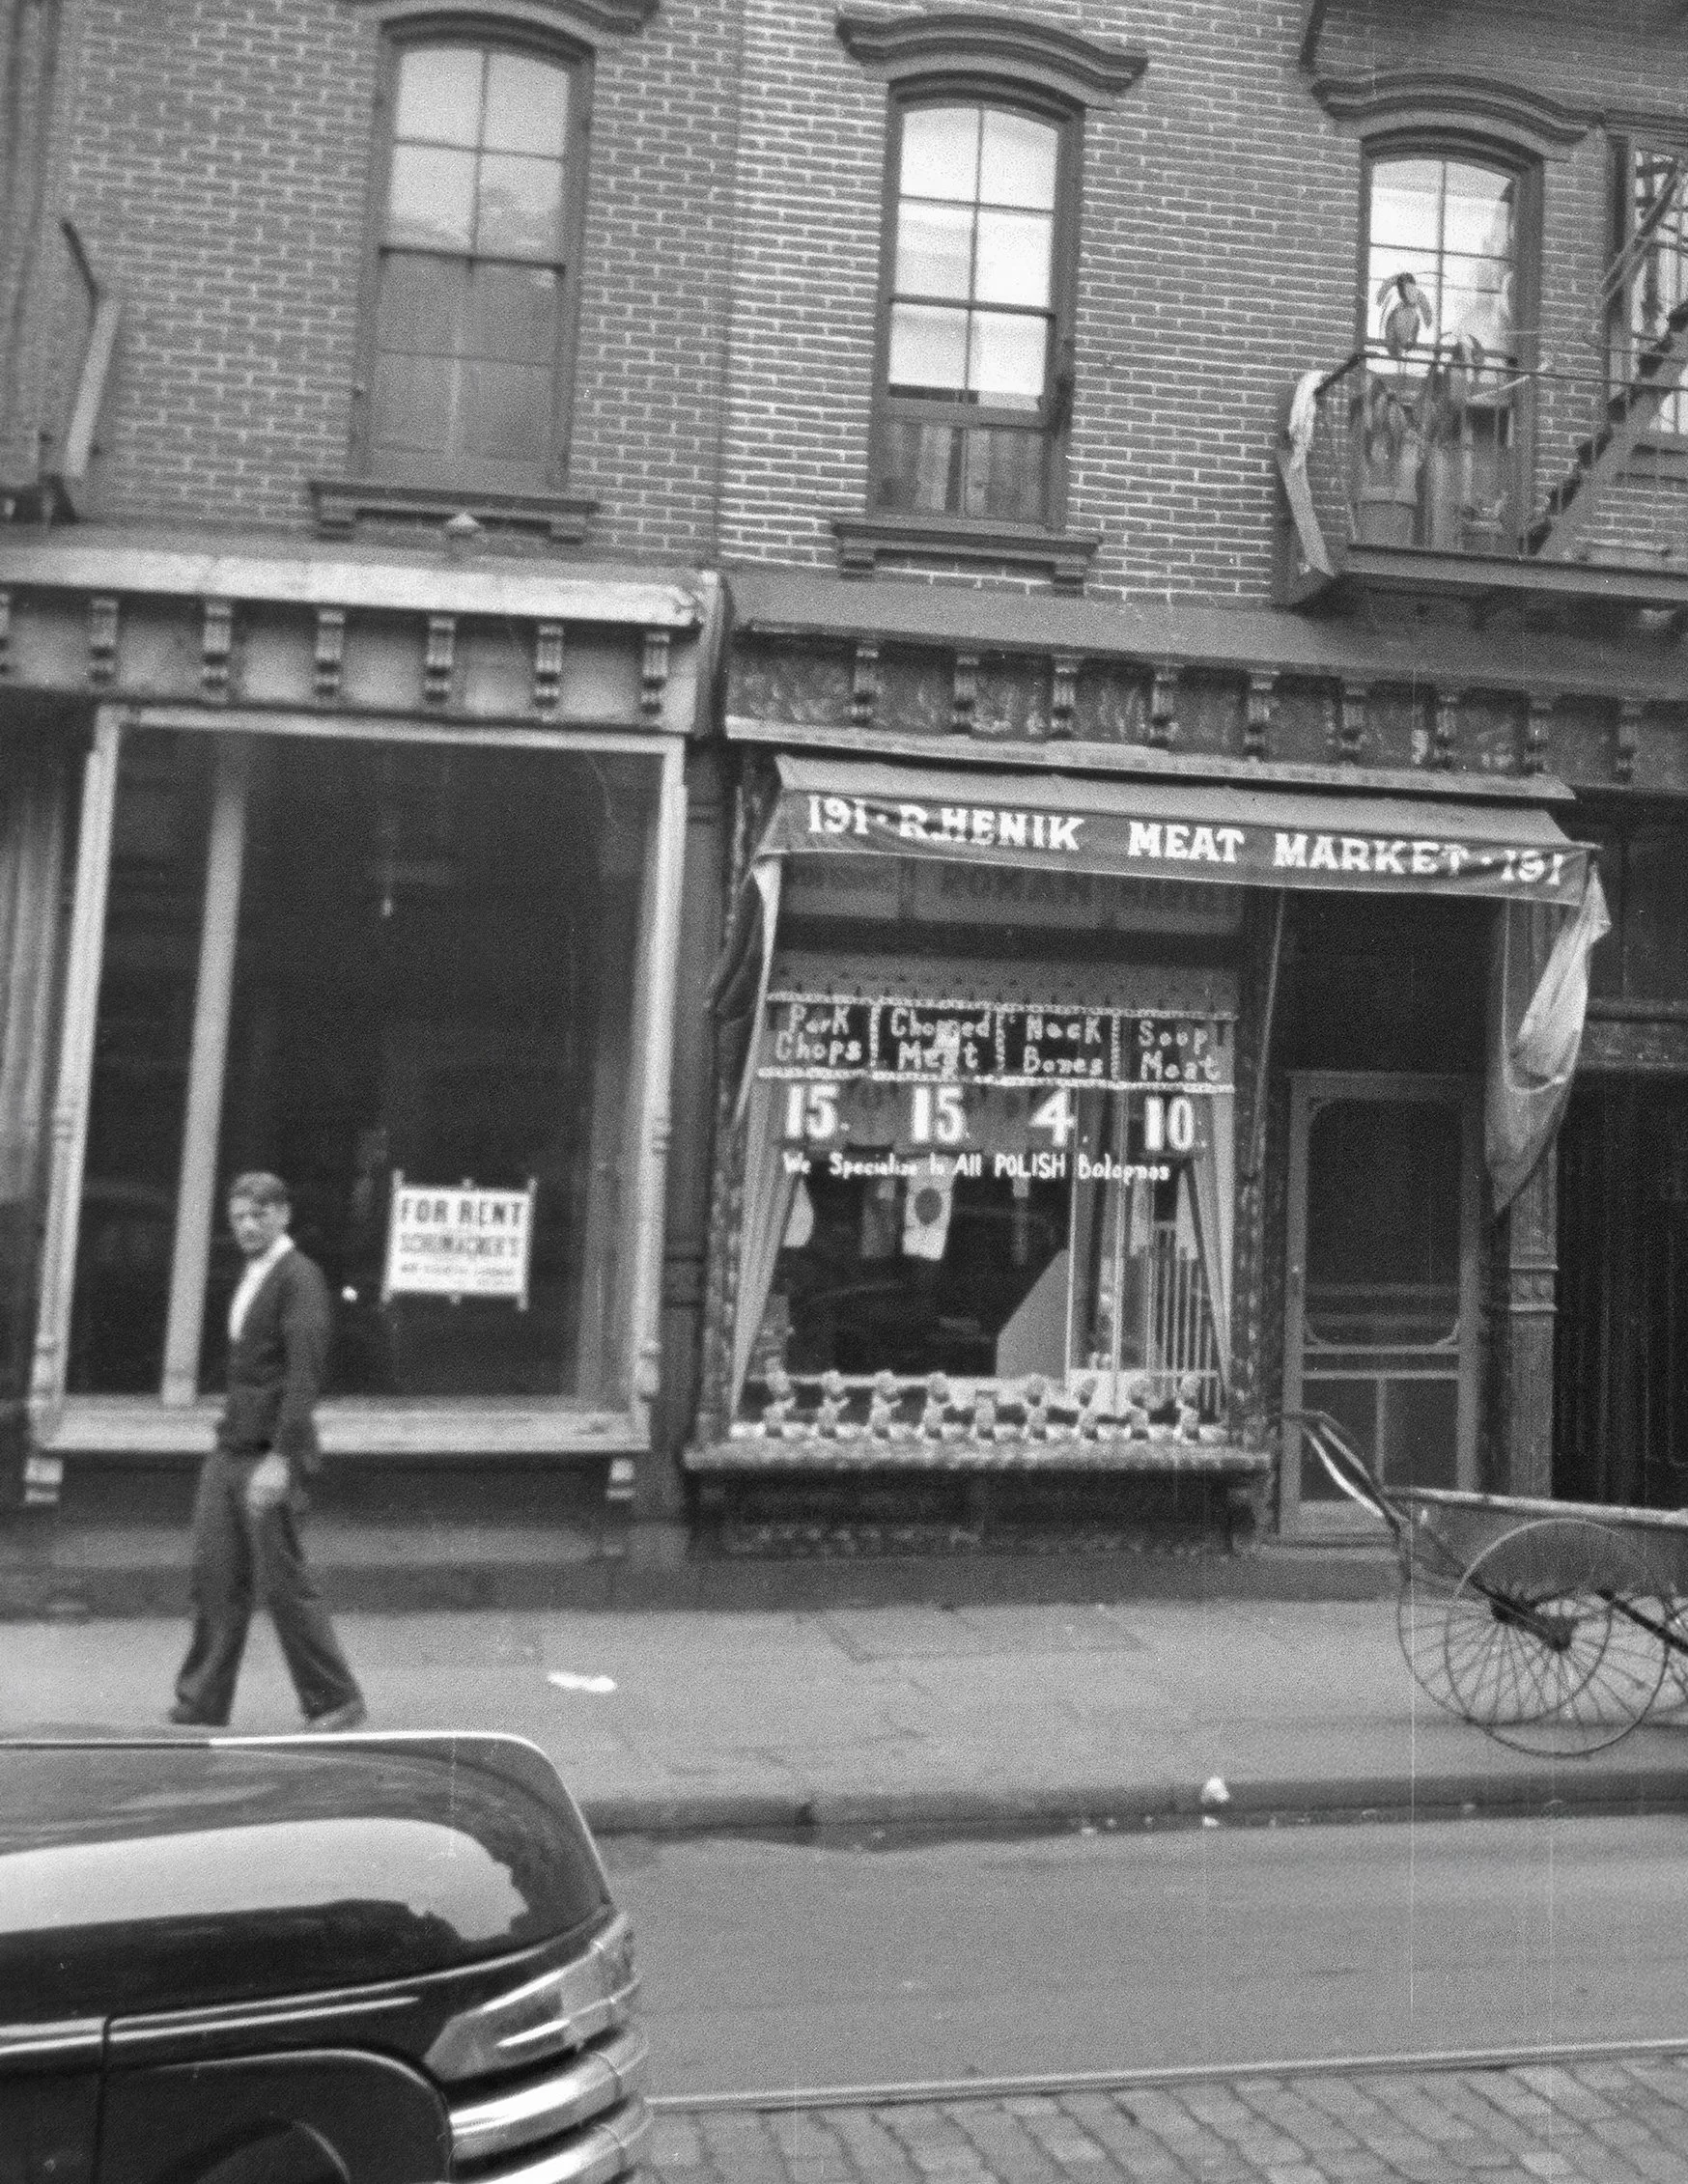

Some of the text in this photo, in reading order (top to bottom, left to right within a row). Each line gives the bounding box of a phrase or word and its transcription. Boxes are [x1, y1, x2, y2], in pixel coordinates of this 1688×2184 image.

[1127, 821, 1246, 863] MEAT
[1272, 831, 1469, 877] MARKET
[889, 1007, 992, 1038] Choed
[1138, 1020, 1209, 1056] Soup
[774, 1029, 862, 1066] Chops
[1024, 1045, 1104, 1077] Bones
[1139, 1050, 1222, 1081] Meat
[911, 1085, 966, 1145] 15
[1143, 1095, 1196, 1152] 10
[994, 1152, 1066, 1180] POLISH
[400, 1196, 522, 1228] FOR RENT
